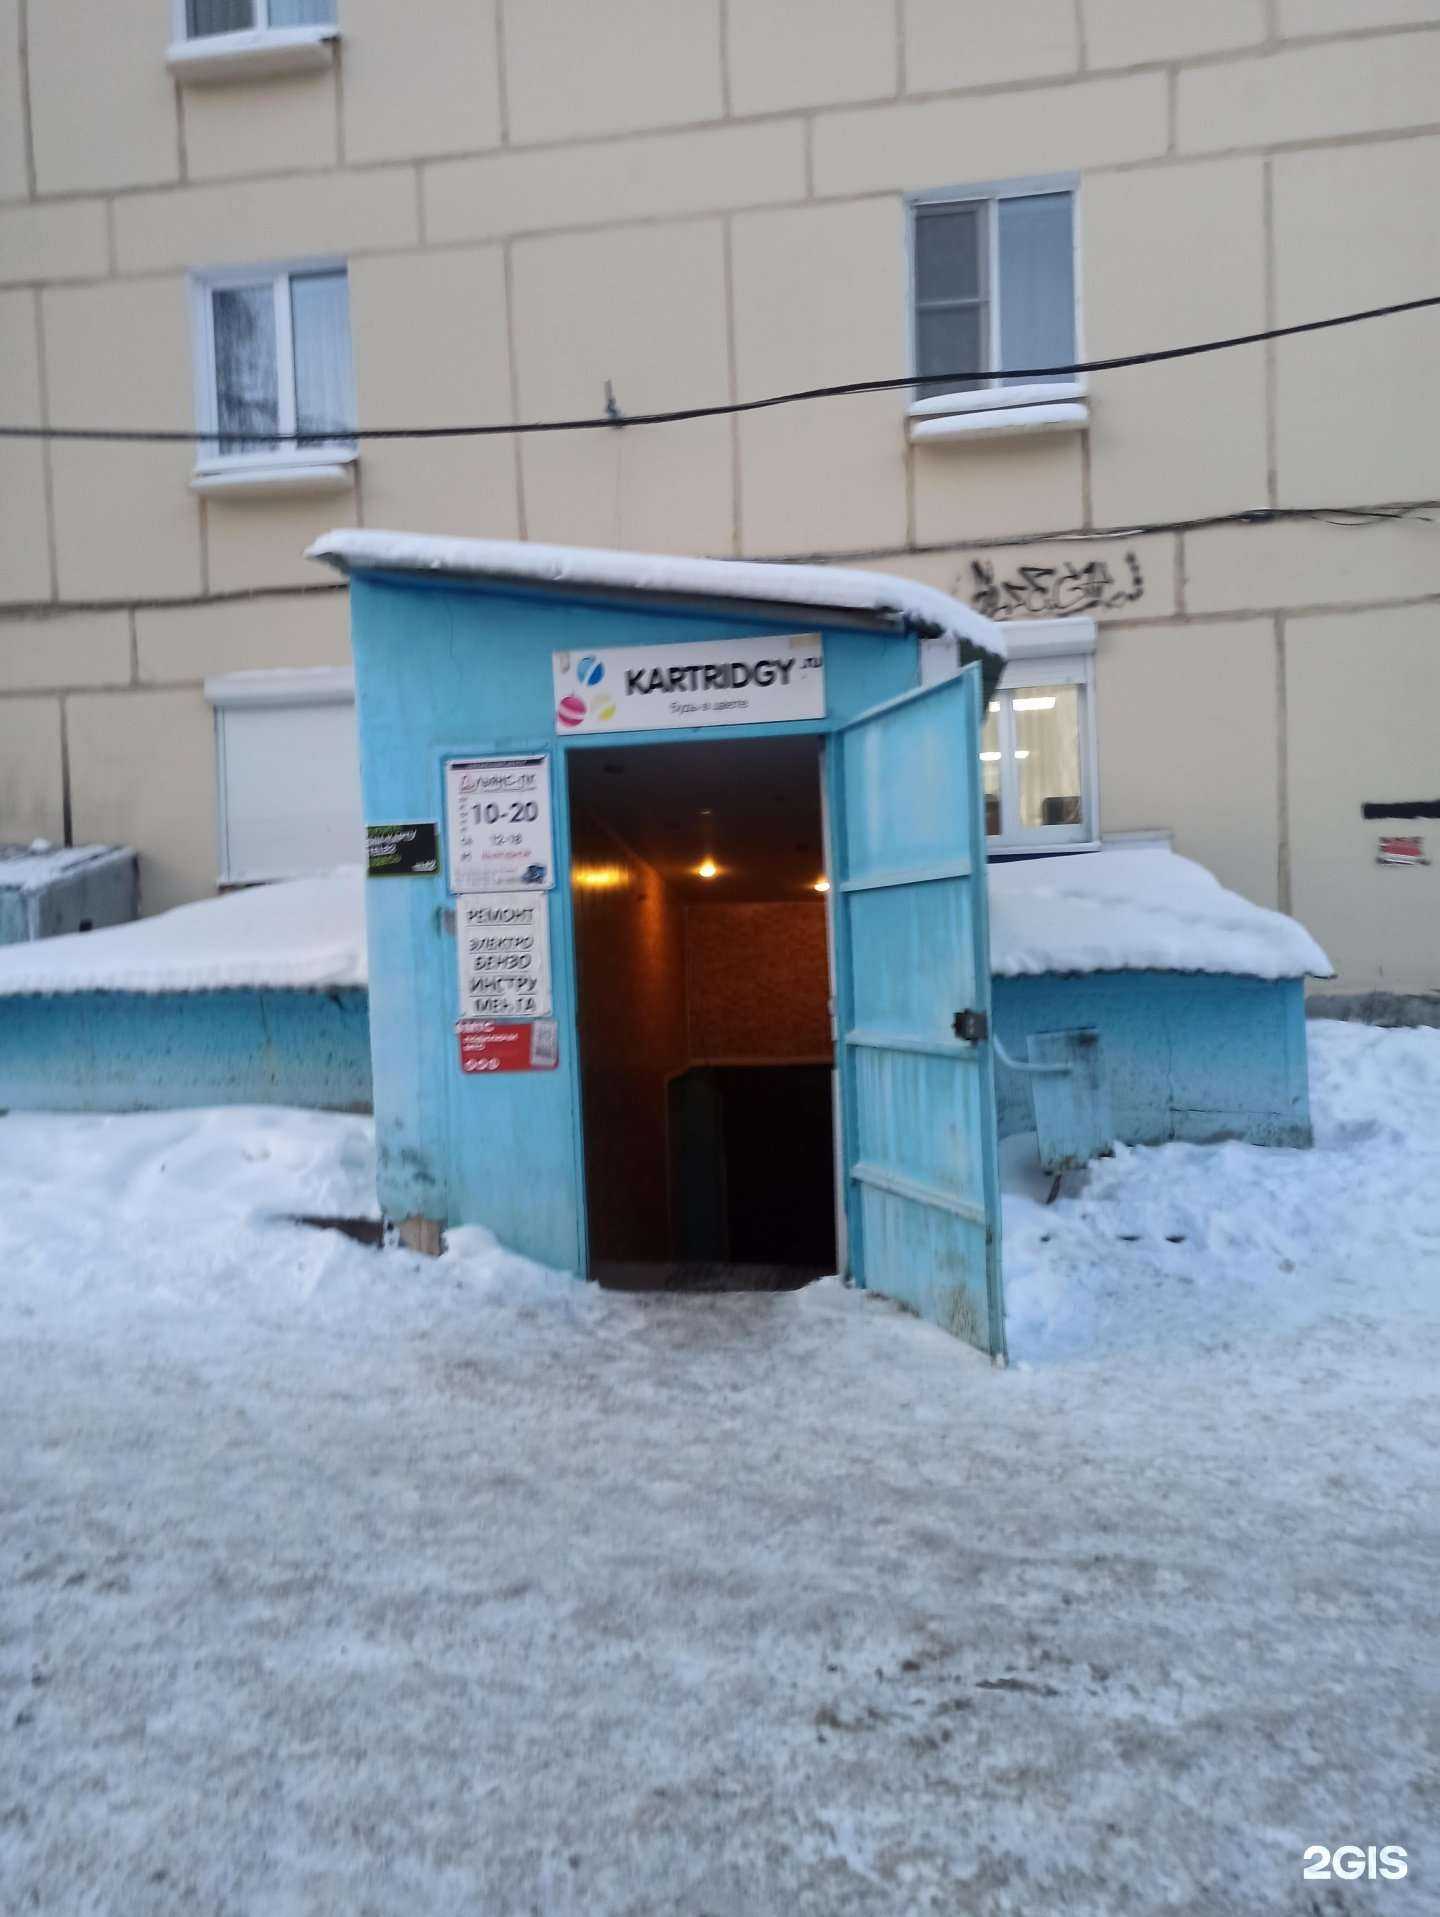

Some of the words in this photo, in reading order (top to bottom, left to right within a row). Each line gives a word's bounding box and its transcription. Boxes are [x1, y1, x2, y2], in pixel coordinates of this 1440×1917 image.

[624, 658, 795, 696] KARTRIDGY
[472, 801, 539, 824] 10-20
[467, 908, 534, 924] РЕМОНТ
[469, 936, 534, 951] ЭЛЕКТРО
[474, 955, 532, 971] БЕНЗО
